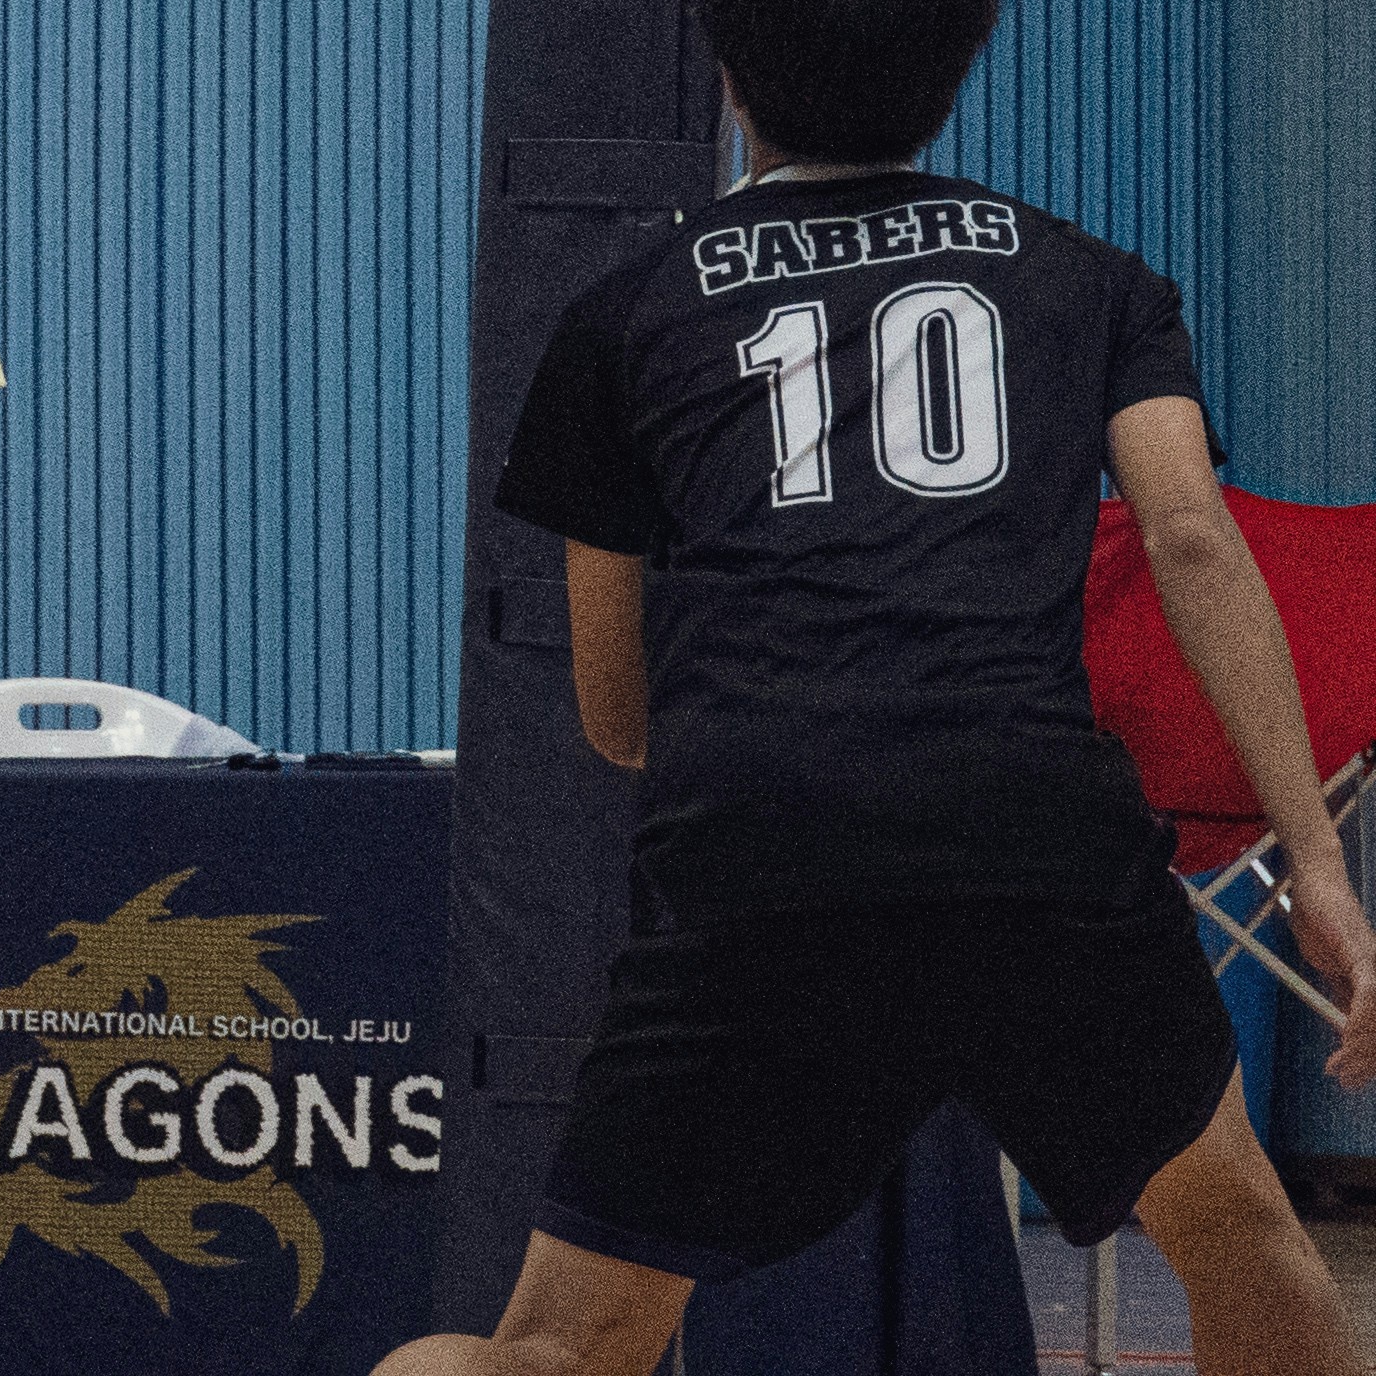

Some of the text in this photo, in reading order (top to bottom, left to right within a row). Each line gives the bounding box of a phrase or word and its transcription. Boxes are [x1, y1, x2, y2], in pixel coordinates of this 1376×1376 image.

[693, 200, 1019, 296] SABERS
[736, 281, 1009, 508] 10
[211, 1013, 334, 1044] SCHOOL,
[343, 1020, 411, 1043] JEJU
